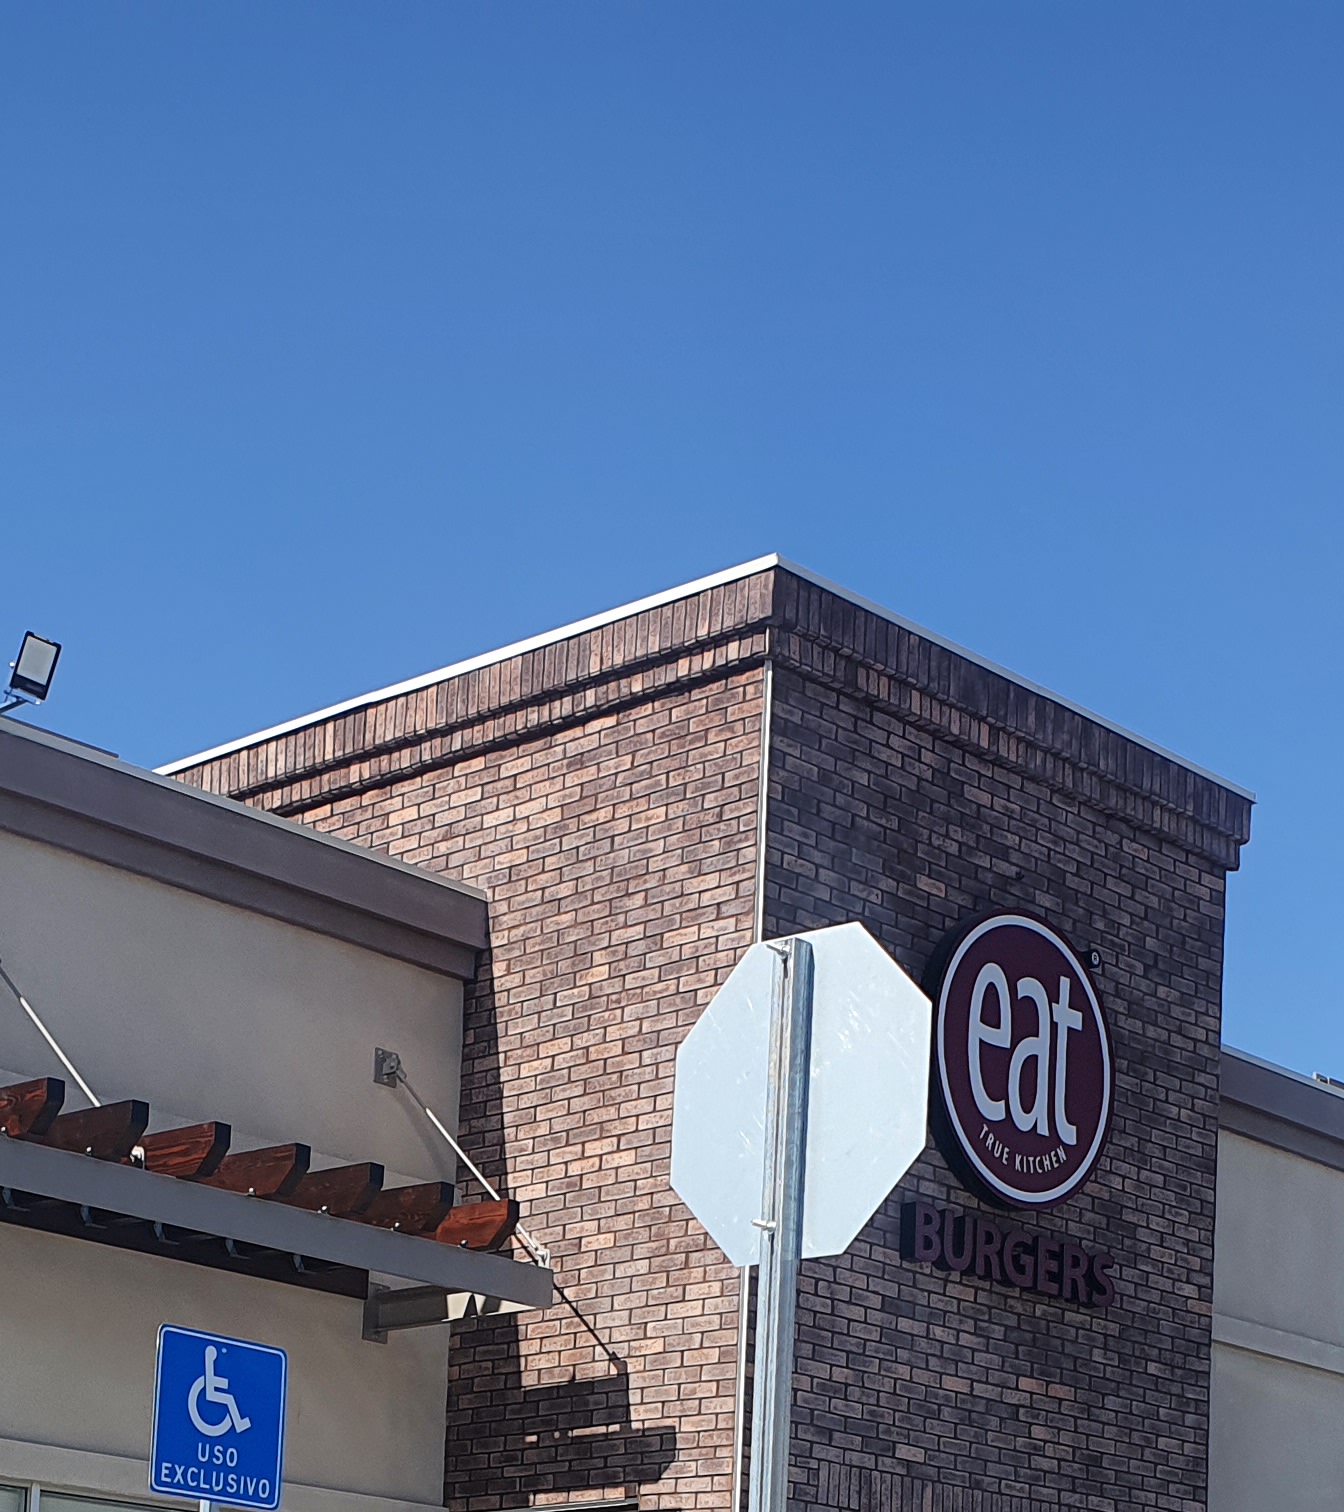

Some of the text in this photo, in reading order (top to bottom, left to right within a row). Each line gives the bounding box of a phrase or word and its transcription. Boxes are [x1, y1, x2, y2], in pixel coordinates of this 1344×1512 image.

[967, 962, 1084, 1146] eat
[979, 1123, 1068, 1174] TRUE KITCHEN
[908, 1202, 1117, 1309] BURGERS
[160, 1462, 271, 1499] EXCLUSIVO
[197, 1442, 238, 1468] USO
